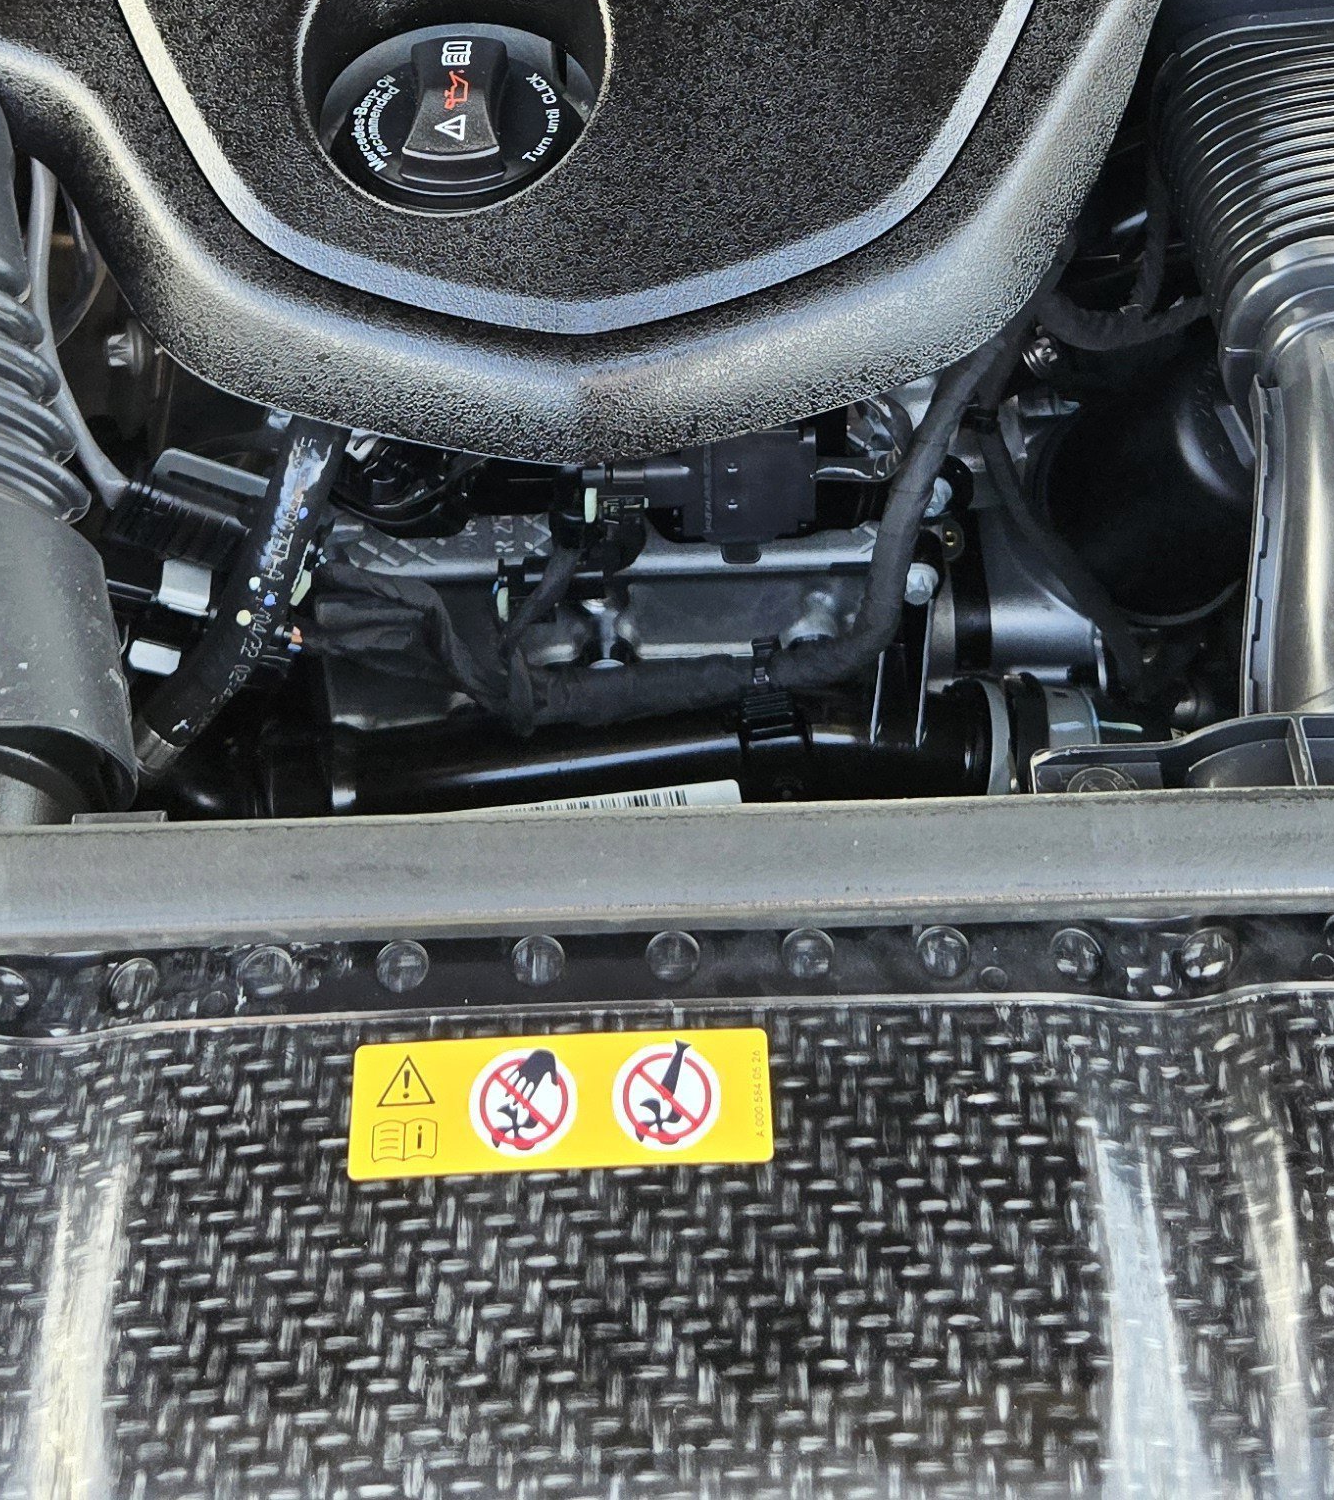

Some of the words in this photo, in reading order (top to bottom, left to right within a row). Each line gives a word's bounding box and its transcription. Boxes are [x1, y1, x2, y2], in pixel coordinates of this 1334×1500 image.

[525, 73, 557, 105] CLICK
[351, 88, 387, 172] Mercedes-Benz
[368, 84, 400, 157] recommended
[546, 108, 560, 134] until
[522, 137, 553, 162] Turn
